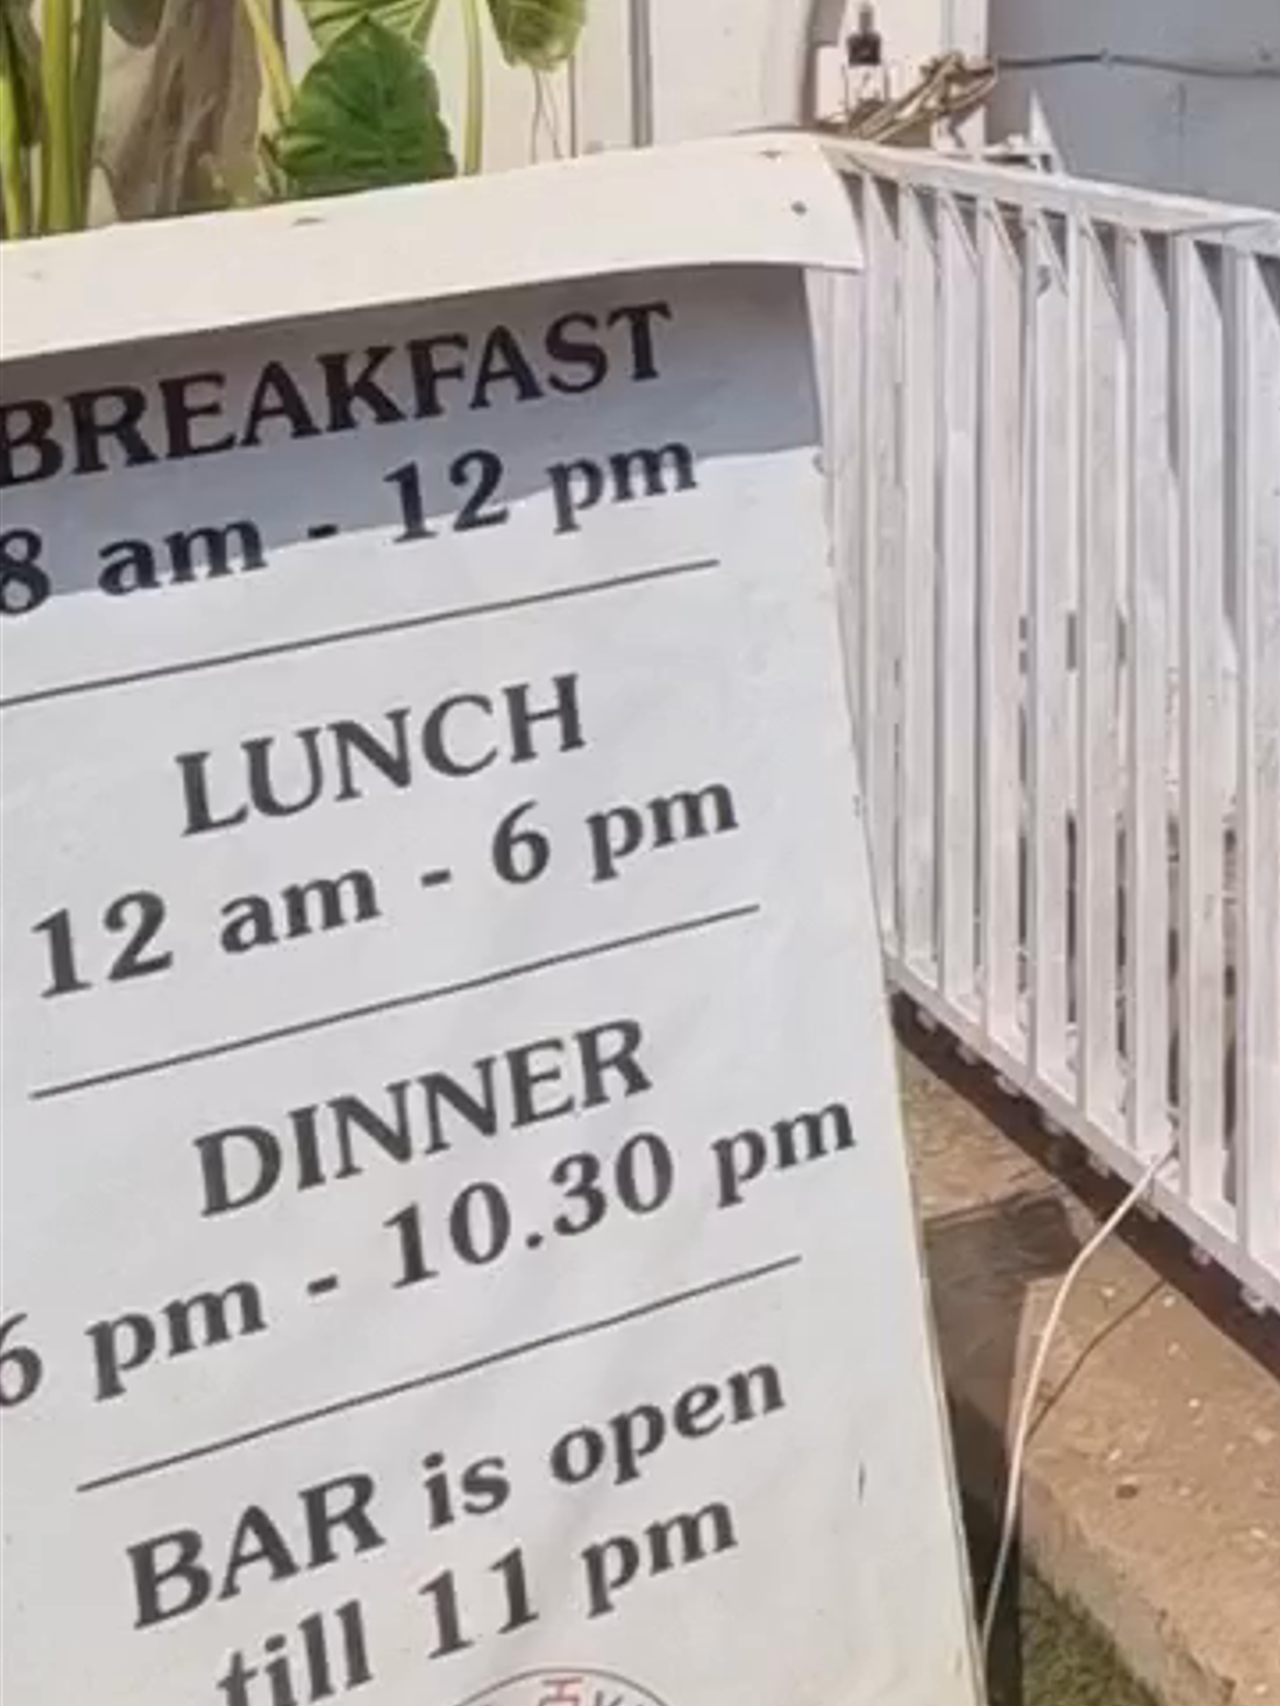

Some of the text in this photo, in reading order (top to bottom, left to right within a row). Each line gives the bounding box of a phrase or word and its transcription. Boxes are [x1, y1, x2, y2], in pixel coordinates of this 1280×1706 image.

[0, 302, 673, 488] BREAKFAST
[0, 529, 53, 616] 8
[97, 518, 267, 596] am
[383, 449, 509, 545] 12
[547, 441, 697, 535] pm
[174, 673, 586, 837] LUNCH
[31, 890, 174, 1000] 12
[219, 867, 382, 954] am
[491, 800, 551, 886] 6
[586, 781, 740, 882] pm
[193, 1018, 655, 1218] DINNER
[84, 1276, 268, 1402] pm
[382, 1132, 674, 1290] 10.30
[710, 1101, 858, 1207] pm
[125, 1359, 787, 1630] BAR is open
[418, 1548, 540, 1661] 11
[582, 1500, 739, 1618] pm
